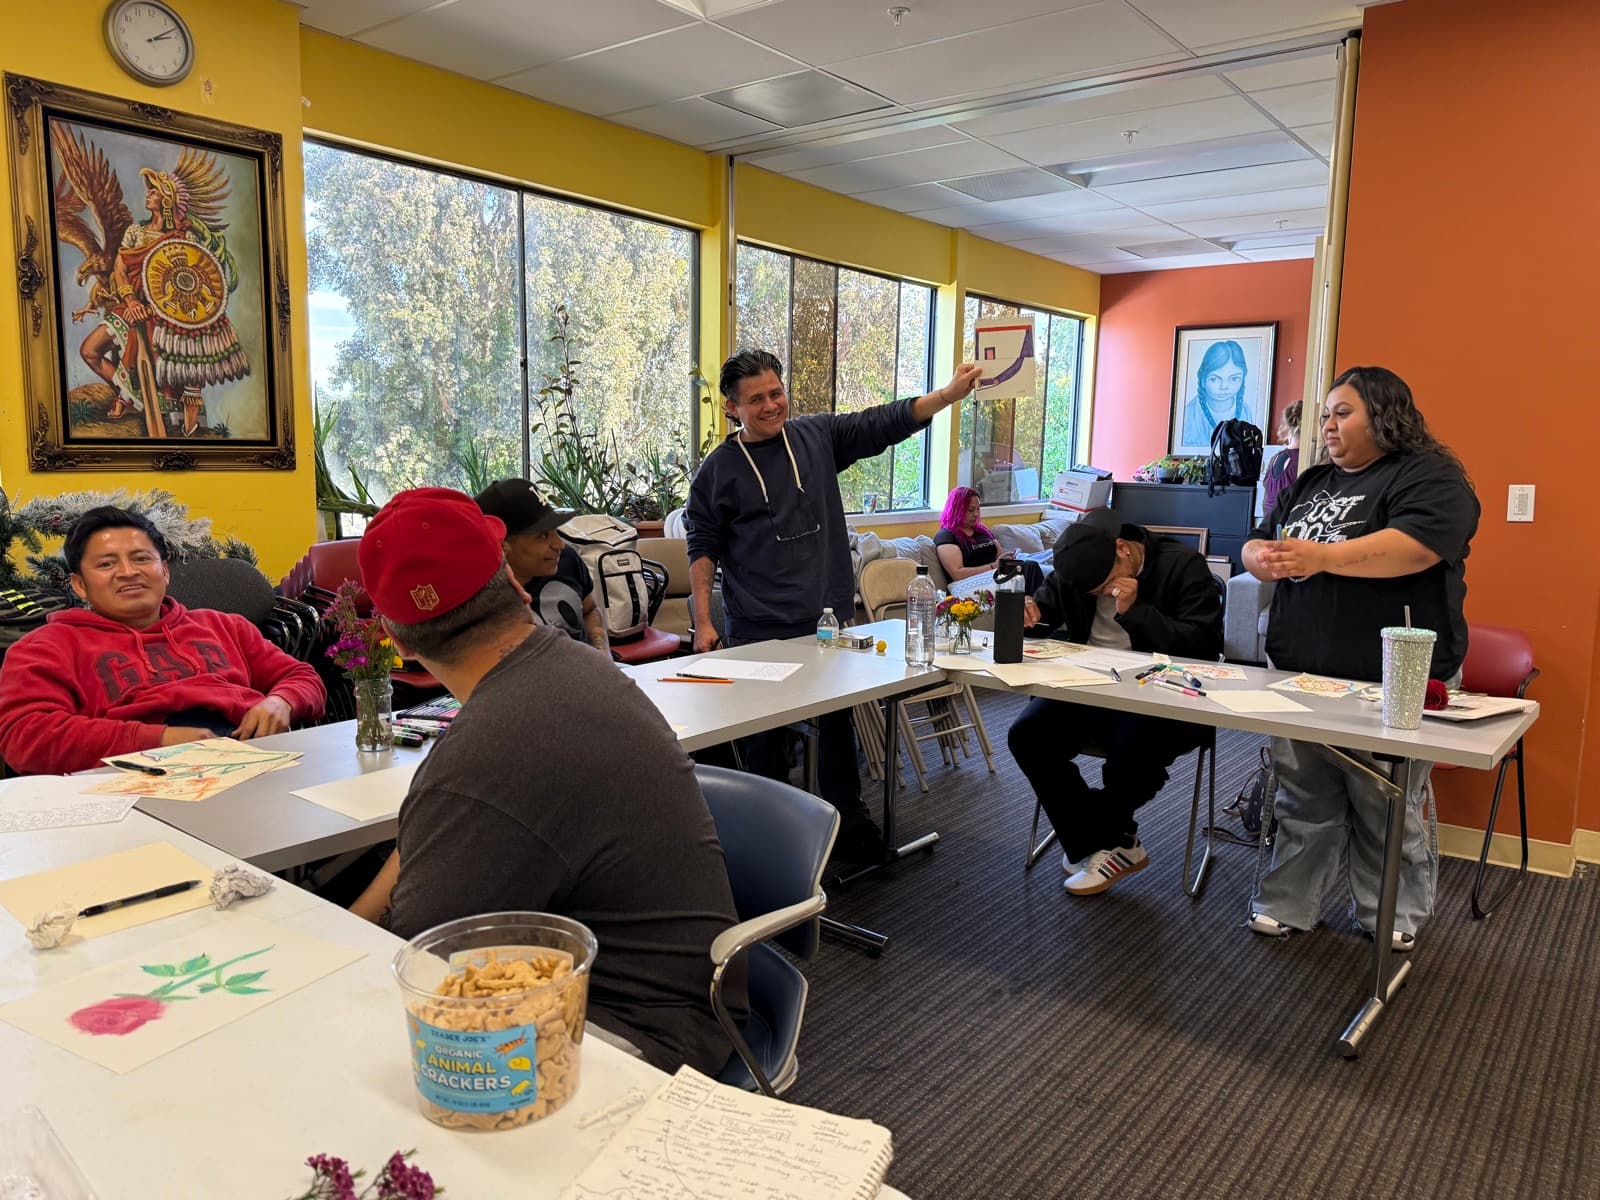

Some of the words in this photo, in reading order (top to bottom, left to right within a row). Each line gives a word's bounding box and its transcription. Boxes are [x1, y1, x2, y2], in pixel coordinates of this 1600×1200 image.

[95, 640, 231, 704] GAP
[434, 1045, 483, 1059] ORGANIC
[428, 1054, 497, 1075] ANIMAL
[420, 1064, 512, 1090] CRACKERS
